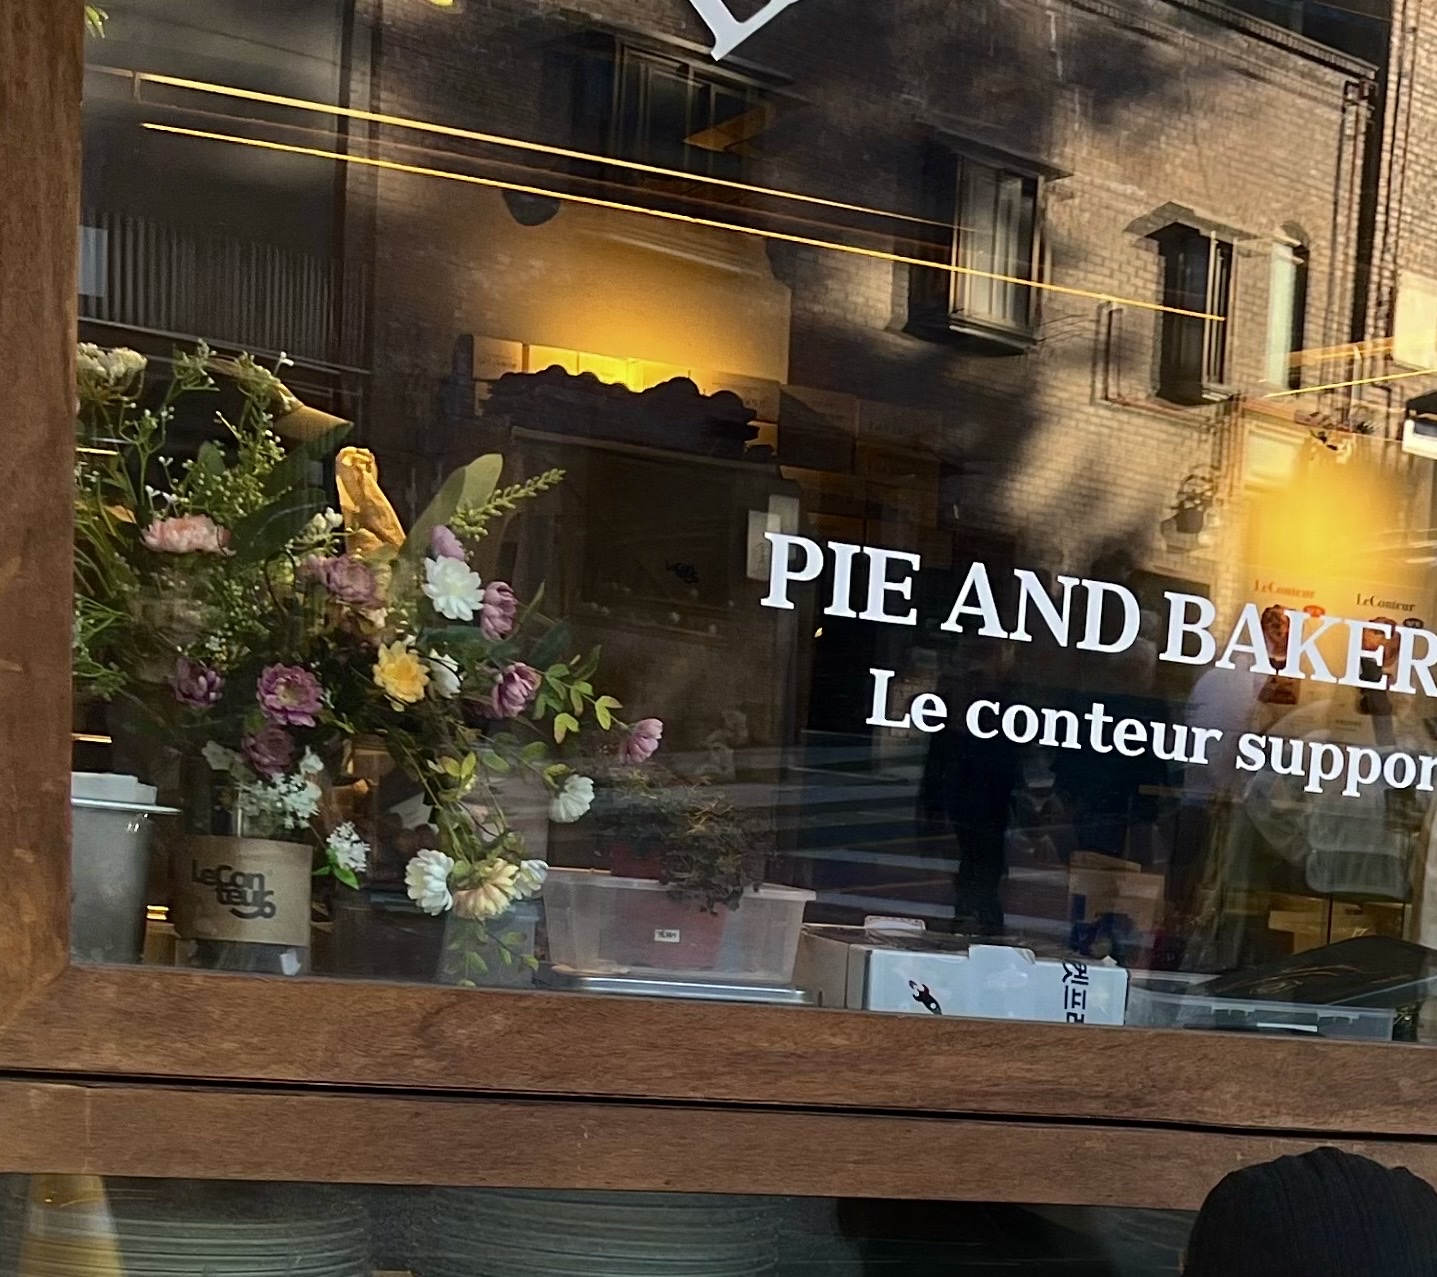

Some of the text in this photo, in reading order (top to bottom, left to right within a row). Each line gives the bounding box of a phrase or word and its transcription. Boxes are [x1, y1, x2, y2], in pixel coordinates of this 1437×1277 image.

[761, 532, 920, 625] PIE
[941, 562, 1139, 652] AND
[866, 669, 947, 732] Le
[966, 701, 1222, 766] conteur
